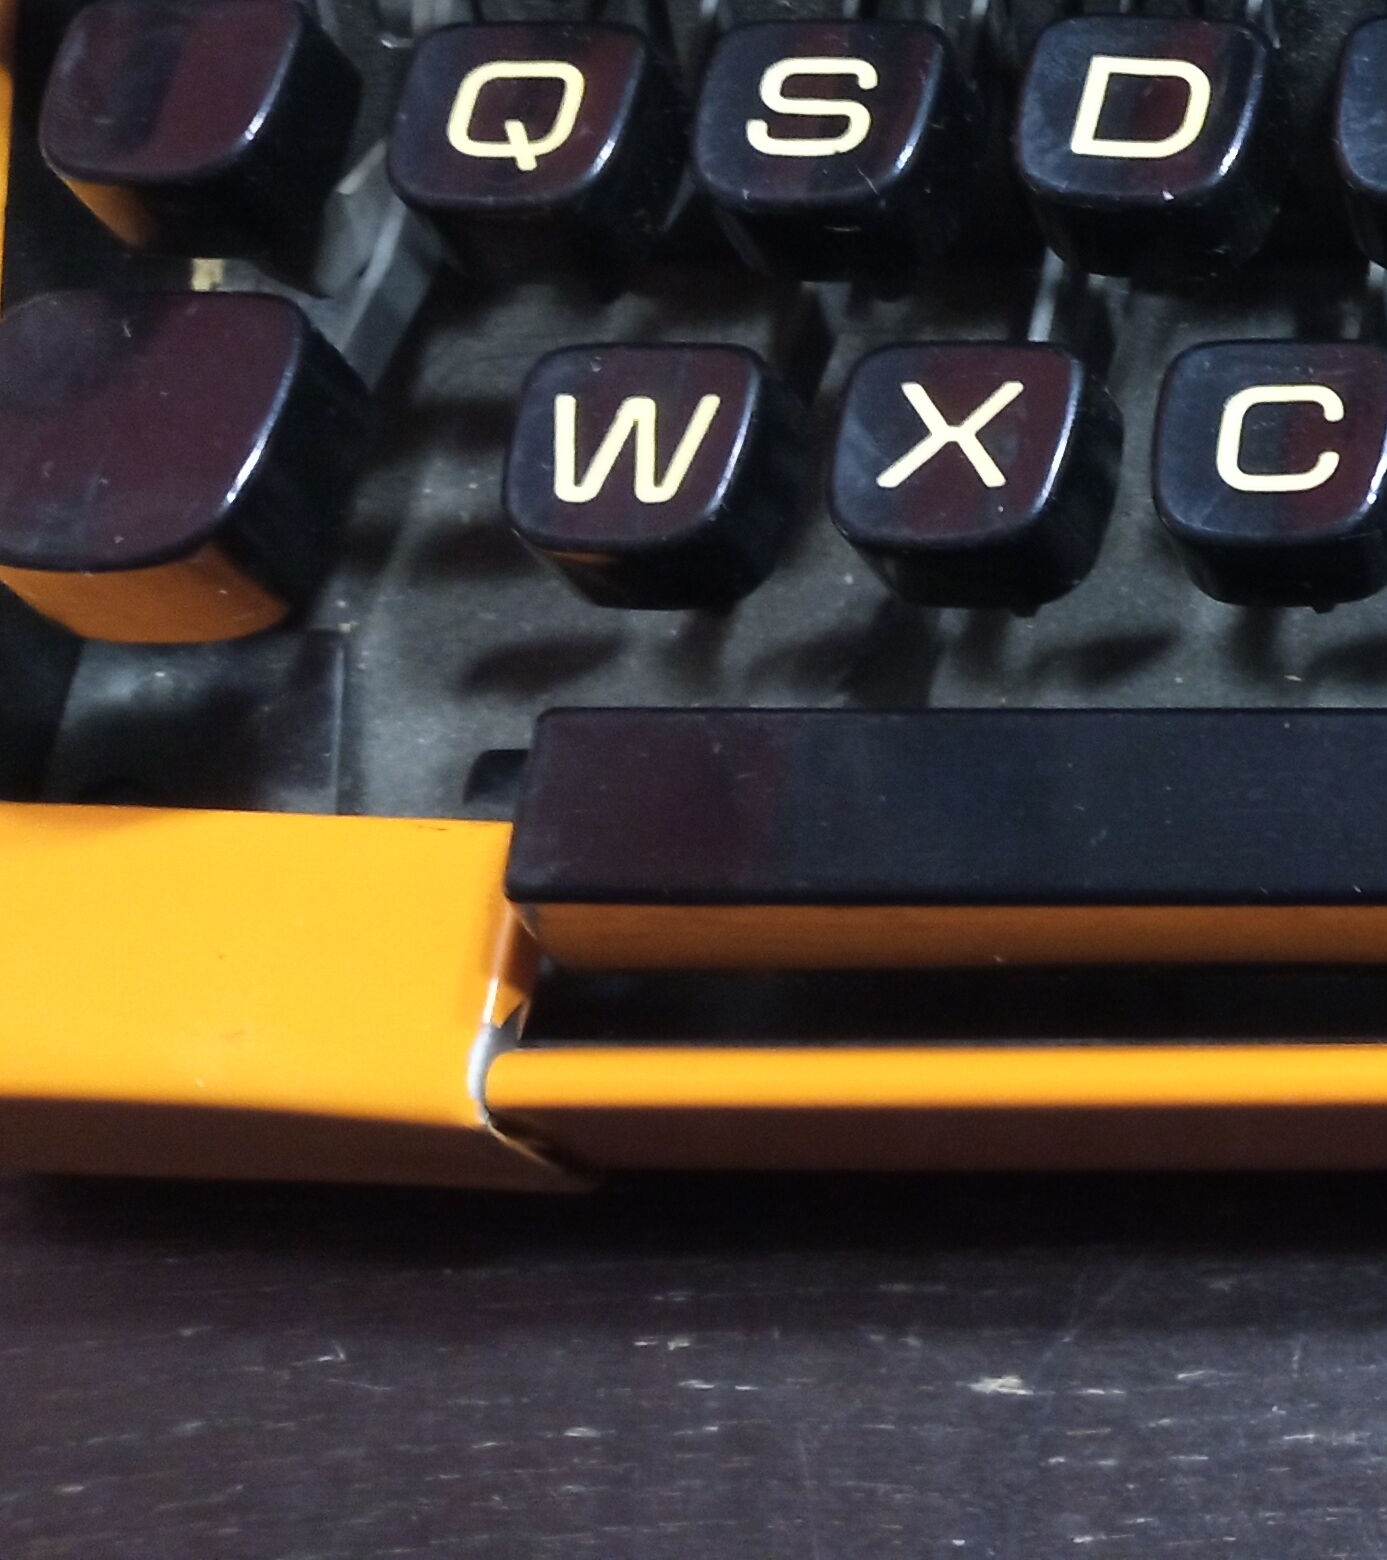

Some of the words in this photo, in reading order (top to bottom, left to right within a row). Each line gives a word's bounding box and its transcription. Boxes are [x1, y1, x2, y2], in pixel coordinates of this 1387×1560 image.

[447, 61, 585, 171] Q
[746, 57, 878, 157] S
[1069, 55, 1211, 158] D
[553, 394, 721, 503] W
[876, 381, 1024, 488] X
[1216, 384, 1344, 492] C
